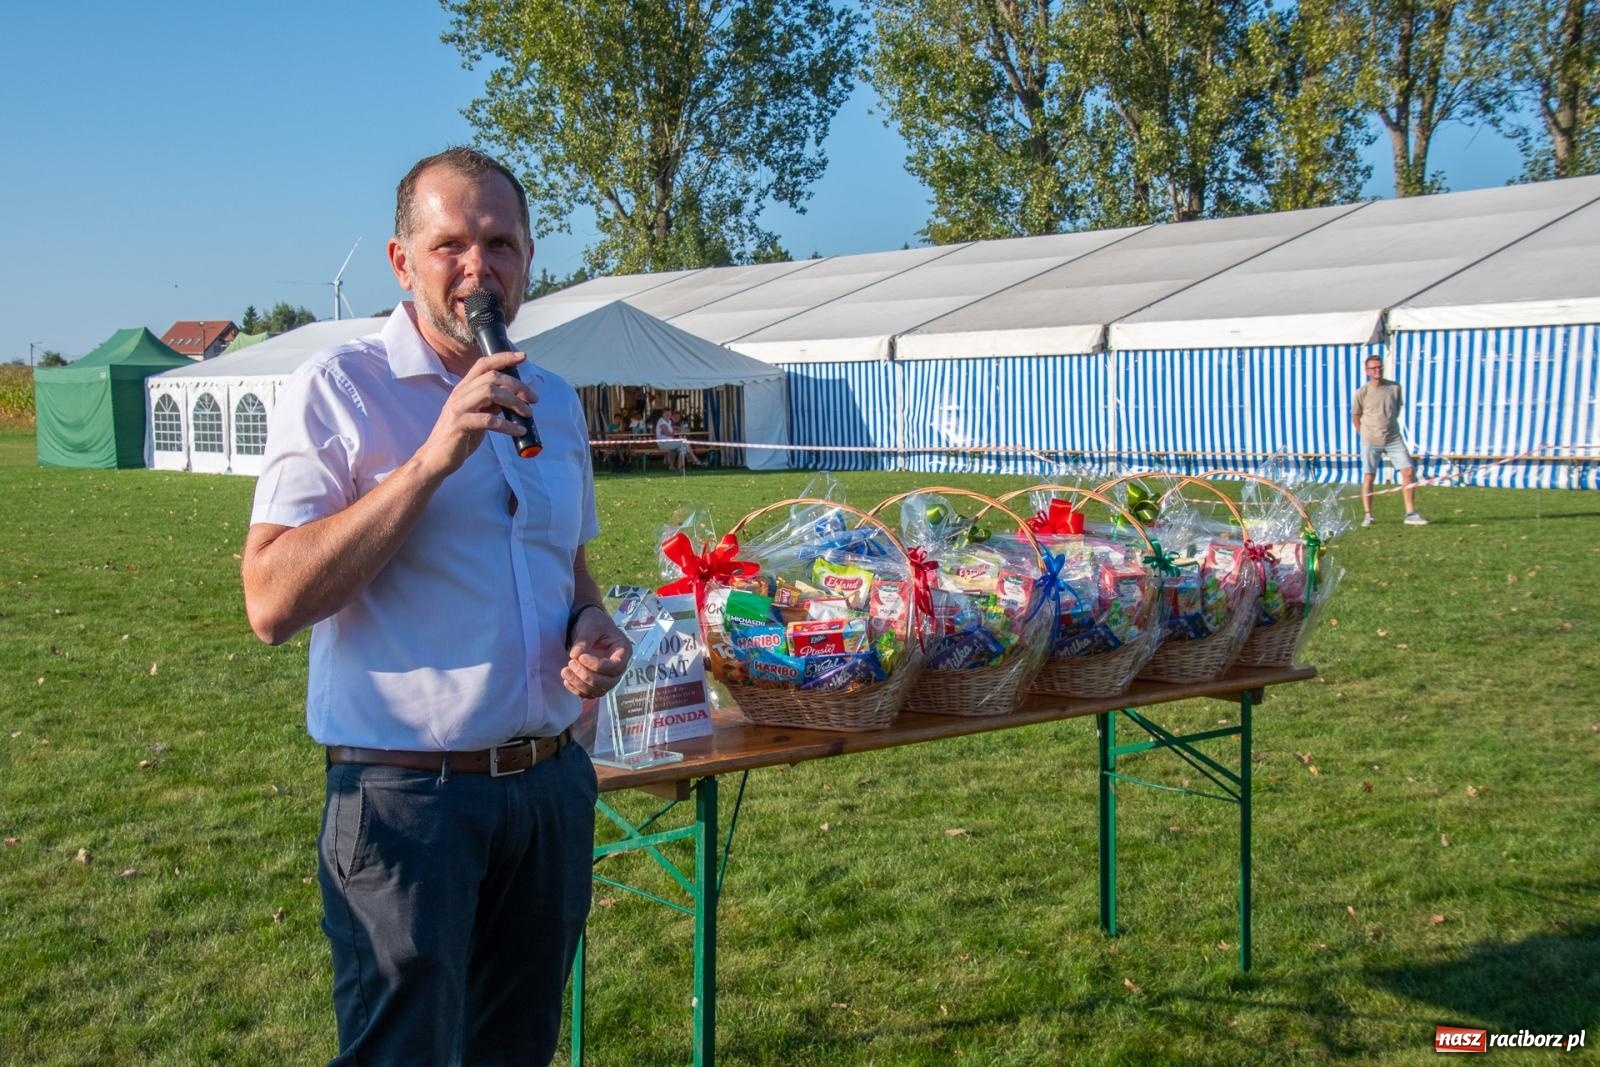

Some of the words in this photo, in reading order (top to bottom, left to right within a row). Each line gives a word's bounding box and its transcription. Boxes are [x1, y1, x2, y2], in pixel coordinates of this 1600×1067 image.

[738, 634, 781, 650] HARIBO
[624, 659, 690, 687] PROSAT
[754, 660, 798, 678] HARIBO
[652, 709, 708, 728] HONDA
